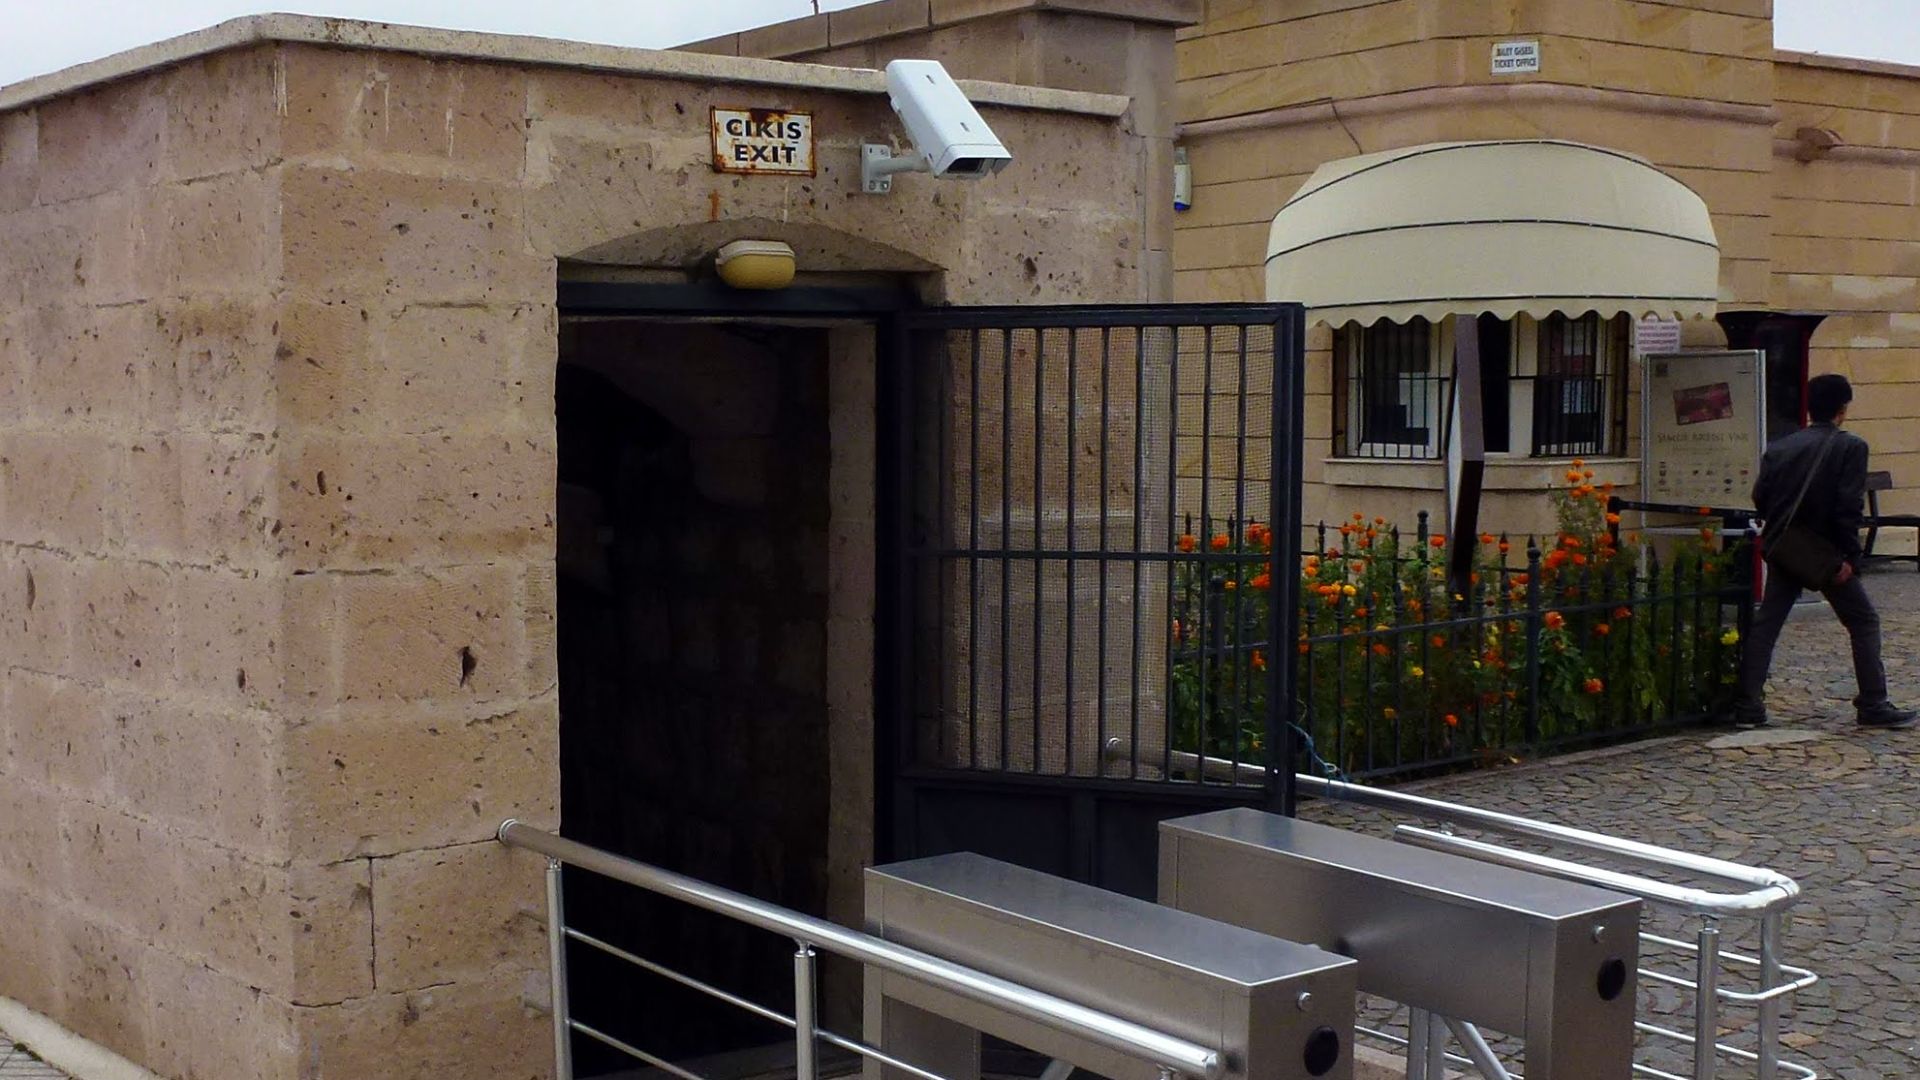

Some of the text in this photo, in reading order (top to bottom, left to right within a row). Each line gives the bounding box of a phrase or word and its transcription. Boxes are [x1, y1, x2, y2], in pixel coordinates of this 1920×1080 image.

[1494, 57, 1537, 68] TICKET OFFICE
[734, 144, 796, 164] EXIT
